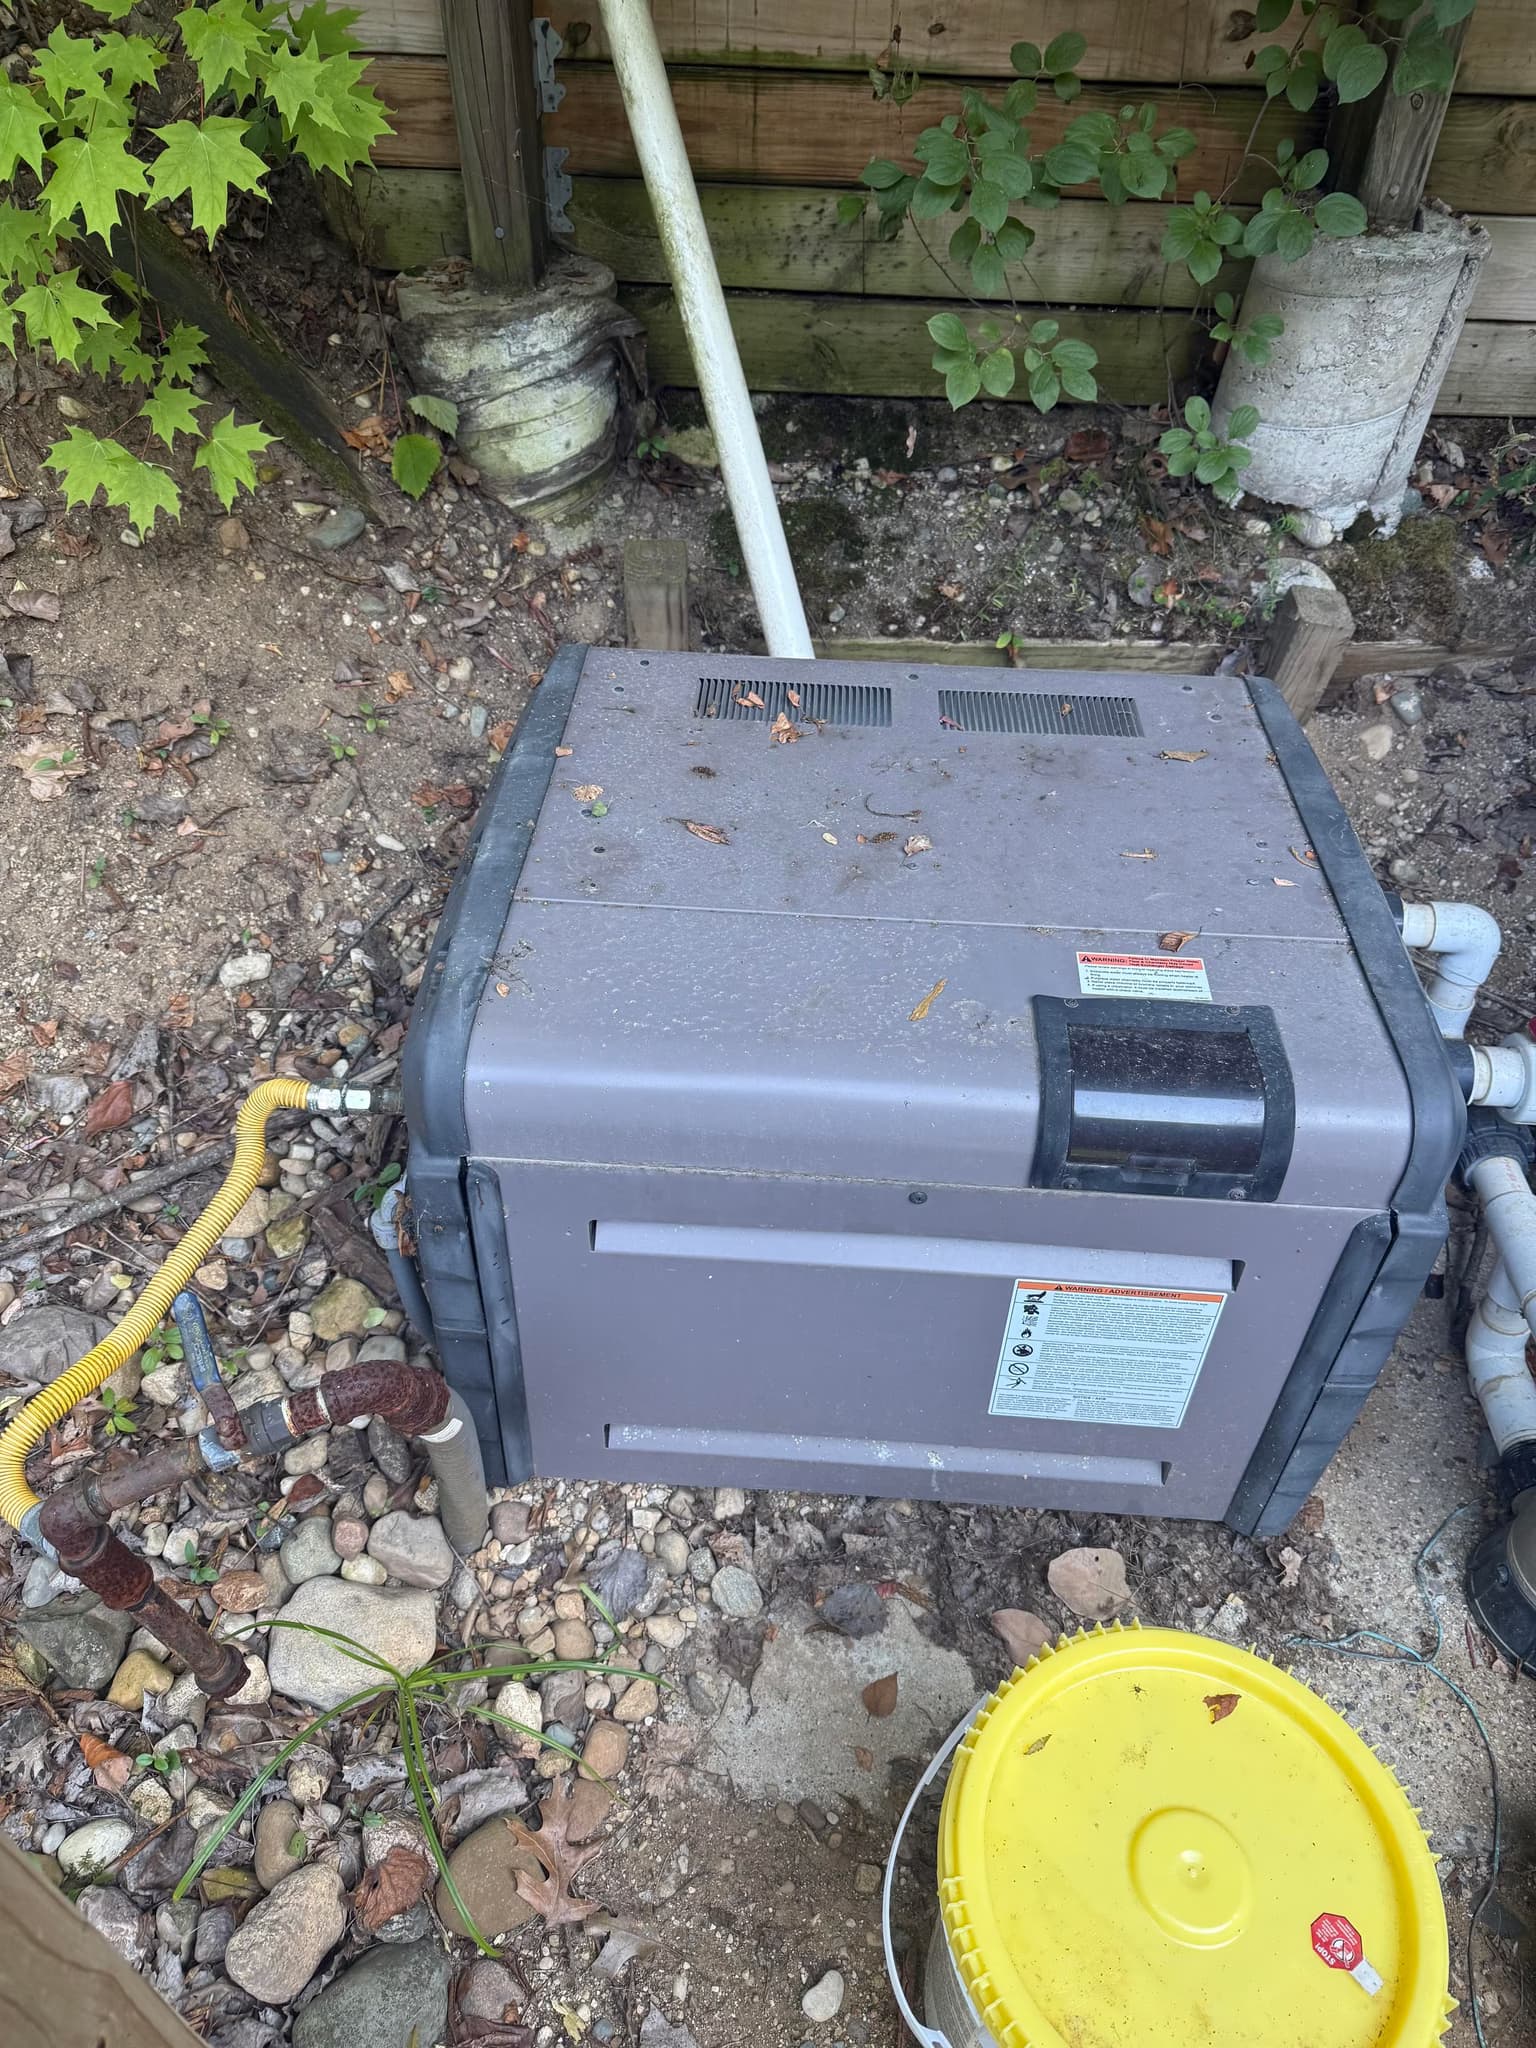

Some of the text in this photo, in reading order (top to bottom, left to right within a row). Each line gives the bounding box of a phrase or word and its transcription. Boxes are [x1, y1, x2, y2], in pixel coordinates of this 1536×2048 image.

[1065, 1285, 1103, 1294] WARNING
[1109, 1289, 1182, 1299] ADVERTISSEMENT
[1314, 1943, 1336, 1965] STOP!
